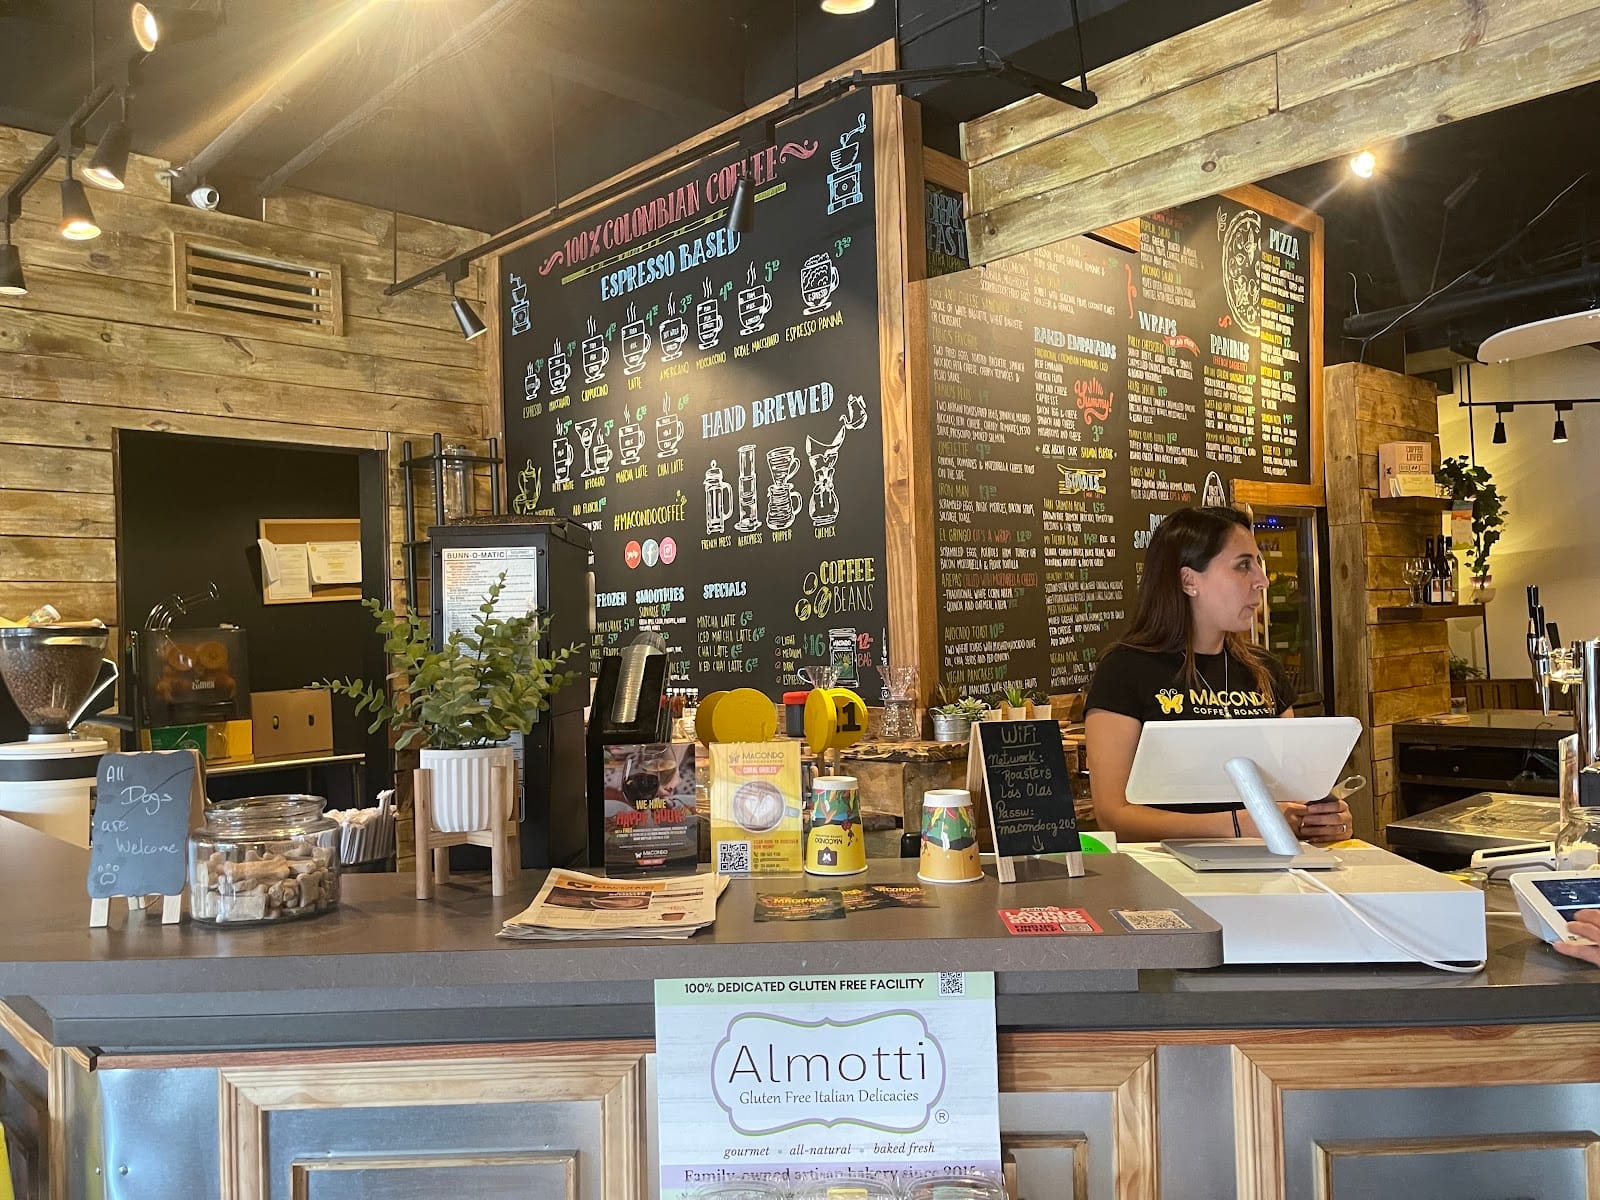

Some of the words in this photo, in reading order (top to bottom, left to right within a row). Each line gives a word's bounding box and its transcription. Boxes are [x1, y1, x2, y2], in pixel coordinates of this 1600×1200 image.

[563, 225, 601, 267] 100%
[603, 180, 700, 249] COLOMBIAN
[1269, 228, 1300, 260] PIZZA
[600, 250, 675, 302] ESPRESSO
[678, 228, 742, 273] BASED
[785, 320, 817, 342] ESPRESSO
[818, 310, 844, 332] PANNA
[1138, 311, 1177, 338] WRAPS
[1034, 326, 1066, 348] BAKED
[628, 377, 643, 391] LATTE
[701, 405, 747, 439] HAND
[752, 381, 834, 428] BREWED
[1068, 446, 1078, 457] OUR
[670, 458, 684, 474] LATTE
[939, 483, 953, 497] IRON
[955, 484, 969, 498] MAN
[614, 503, 686, 531] #MACONDOCOFFEE
[719, 535, 732, 547] PRESS
[814, 526, 836, 539] CHEMEX
[948, 528, 971, 542] GRINGO
[446, 551, 505, 559] BUNN-O-MATIC
[820, 557, 875, 584] COFFEE
[942, 573, 962, 587] AREPAS
[635, 586, 684, 604] SMOOTHIES
[702, 581, 747, 599] SPECIALS
[596, 592, 627, 608] FROZEN
[833, 584, 874, 614] BEANS
[696, 616, 719, 629] MATCHA
[720, 613, 736, 626] LATTE
[697, 632, 710, 644] ICED
[711, 631, 733, 643] MATCHA
[735, 629, 752, 642] LATTE
[972, 625, 987, 639] TOAST
[698, 645, 712, 657] CHAI
[714, 645, 728, 657] LATTE
[802, 633, 826, 657] $16
[728, 660, 743, 673] LATTE
[1189, 689, 1274, 708] MACOND
[836, 701, 862, 732] 1
[1193, 706, 1231, 716] COFFE
[1001, 724, 1037, 744] WiFi
[742, 752, 784, 760] MACONDO
[988, 749, 1045, 766] Network:
[106, 765, 125, 783] All
[1001, 766, 1052, 788] Roasters
[1000, 782, 1021, 799] Las
[1026, 780, 1053, 797] Olas
[120, 785, 173, 815] Dogs
[636, 800, 648, 809] WE
[649, 799, 667, 809] HAVE
[997, 800, 1034, 819] Passw:
[101, 819, 129, 832] are
[616, 811, 647, 828] HAPPY
[115, 837, 177, 854] Welcome
[815, 837, 843, 845] MACONDO
[684, 983, 715, 994] 100%
[717, 981, 786, 994] DEDICATED
[788, 980, 837, 992] GLUTEN
[839, 979, 867, 991] FREE
[869, 978, 925, 990] FACILITY
[728, 1041, 928, 1084] Almotti
[739, 1090, 782, 1106] Gluten
[785, 1090, 812, 1104] Free
[814, 1089, 855, 1104] Italian
[858, 1088, 919, 1103] Delicacies
[723, 1146, 771, 1160] gourmet
[789, 1143, 852, 1157] all-natural
[873, 1142, 907, 1155] baked
[907, 1141, 936, 1156] fresh
[684, 1168, 790, 1183] Family-owned
